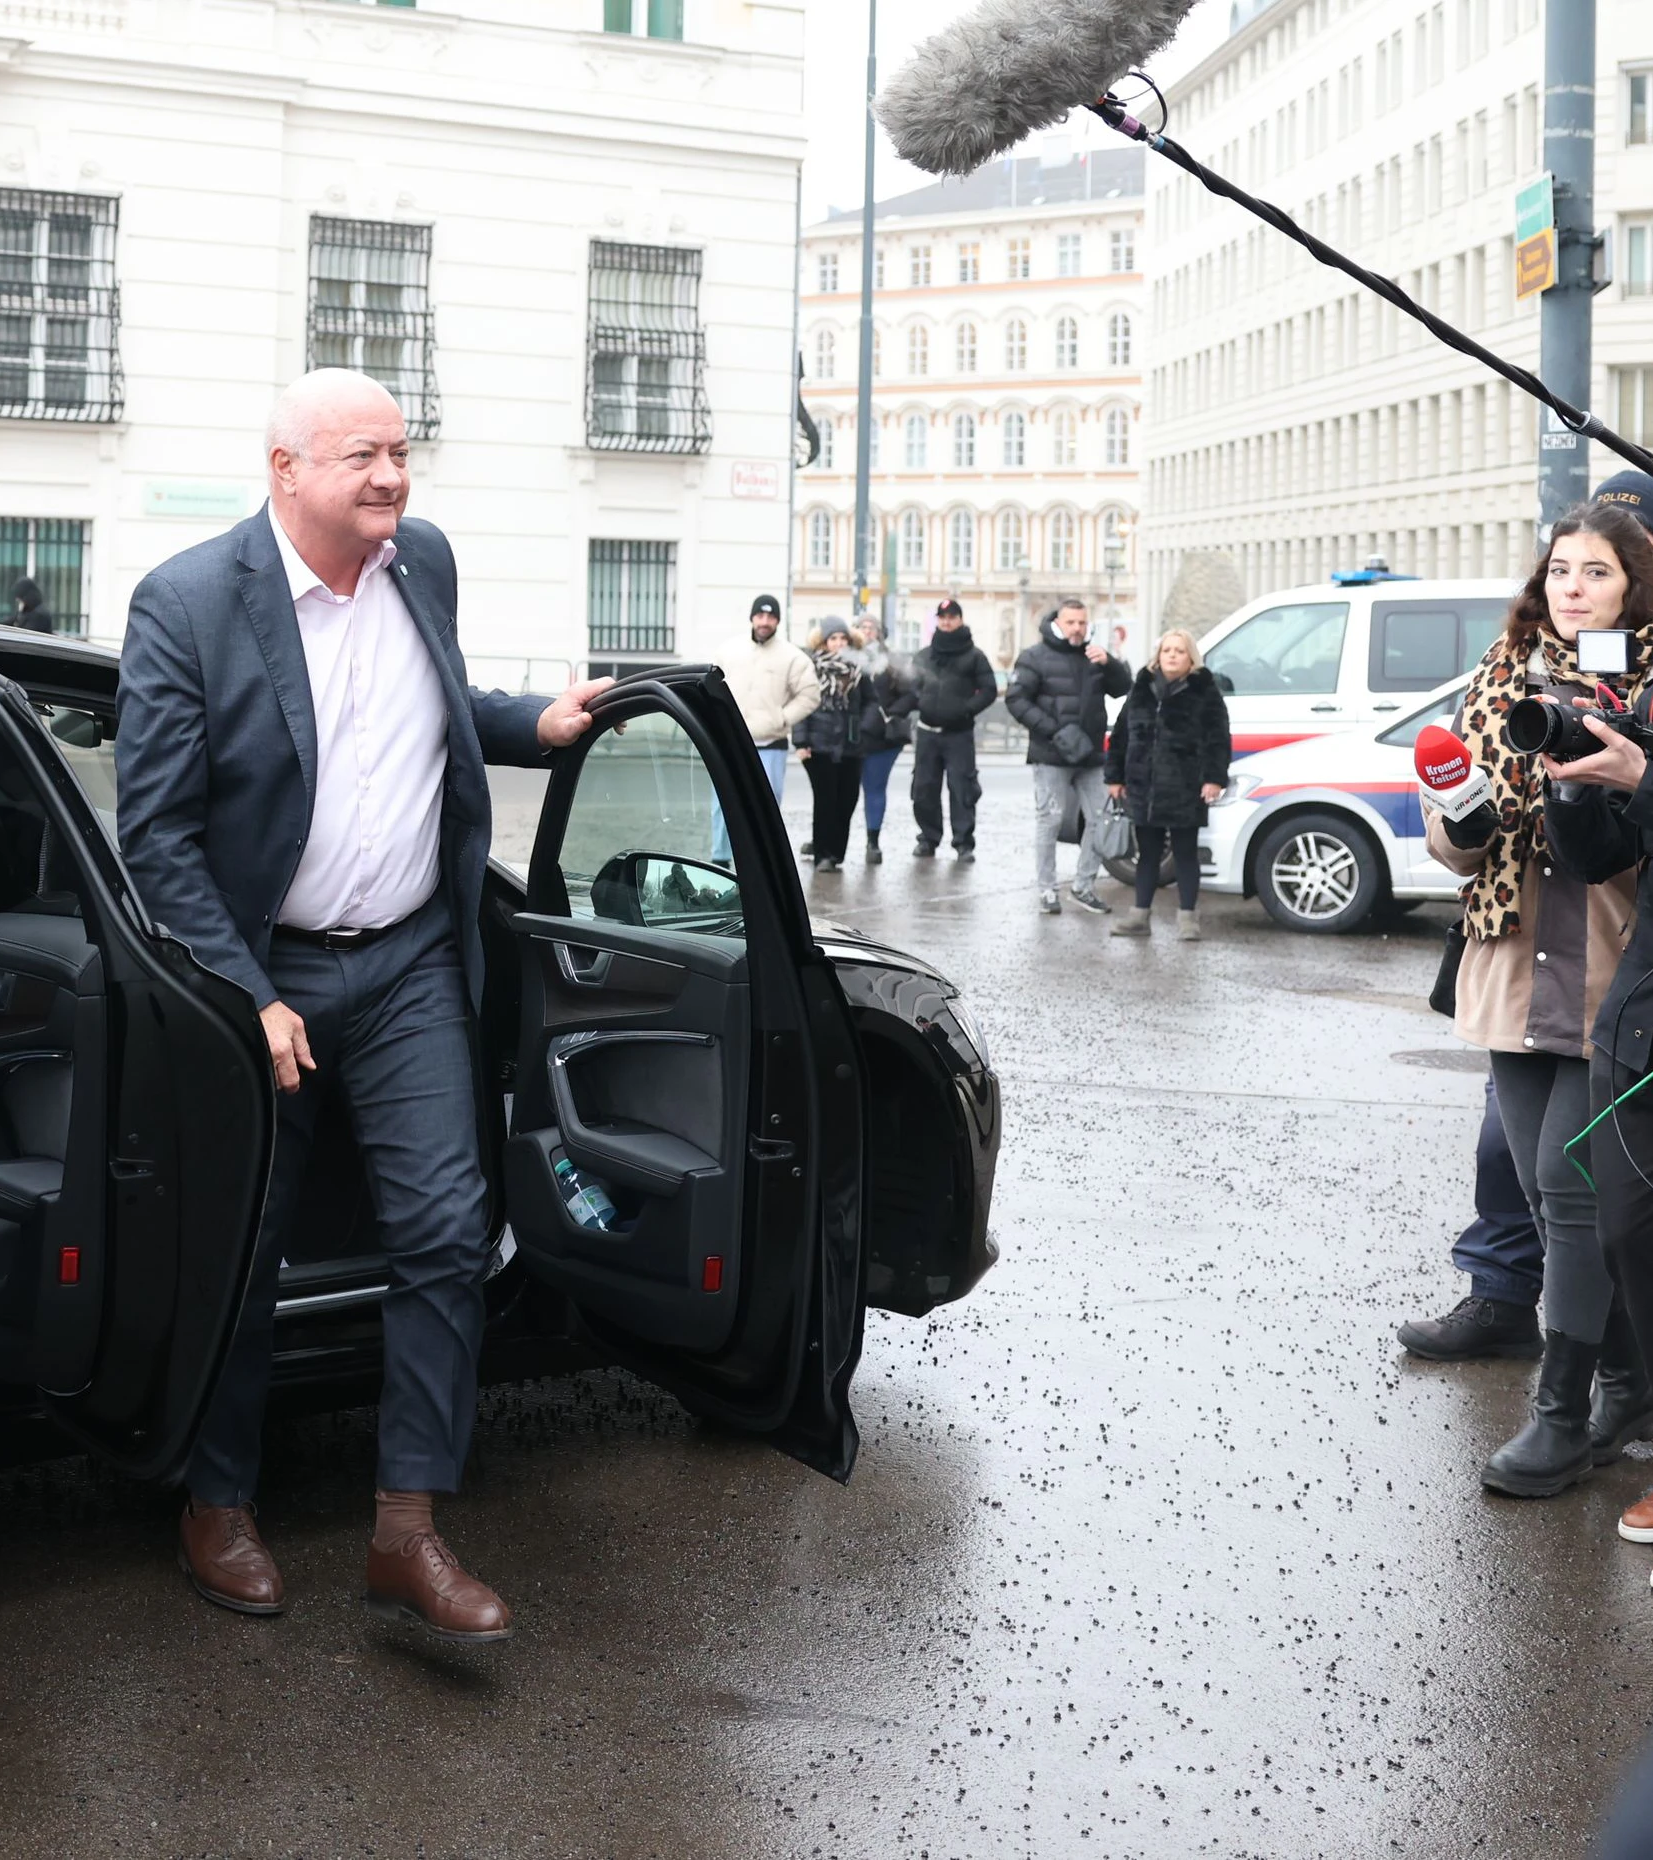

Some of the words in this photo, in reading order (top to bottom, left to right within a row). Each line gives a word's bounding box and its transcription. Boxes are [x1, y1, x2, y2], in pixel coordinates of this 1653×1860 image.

[1597, 492, 1641, 505] POLIZEI
[1425, 756, 1463, 776] Kronen
[1430, 767, 1467, 785] Zeitung
